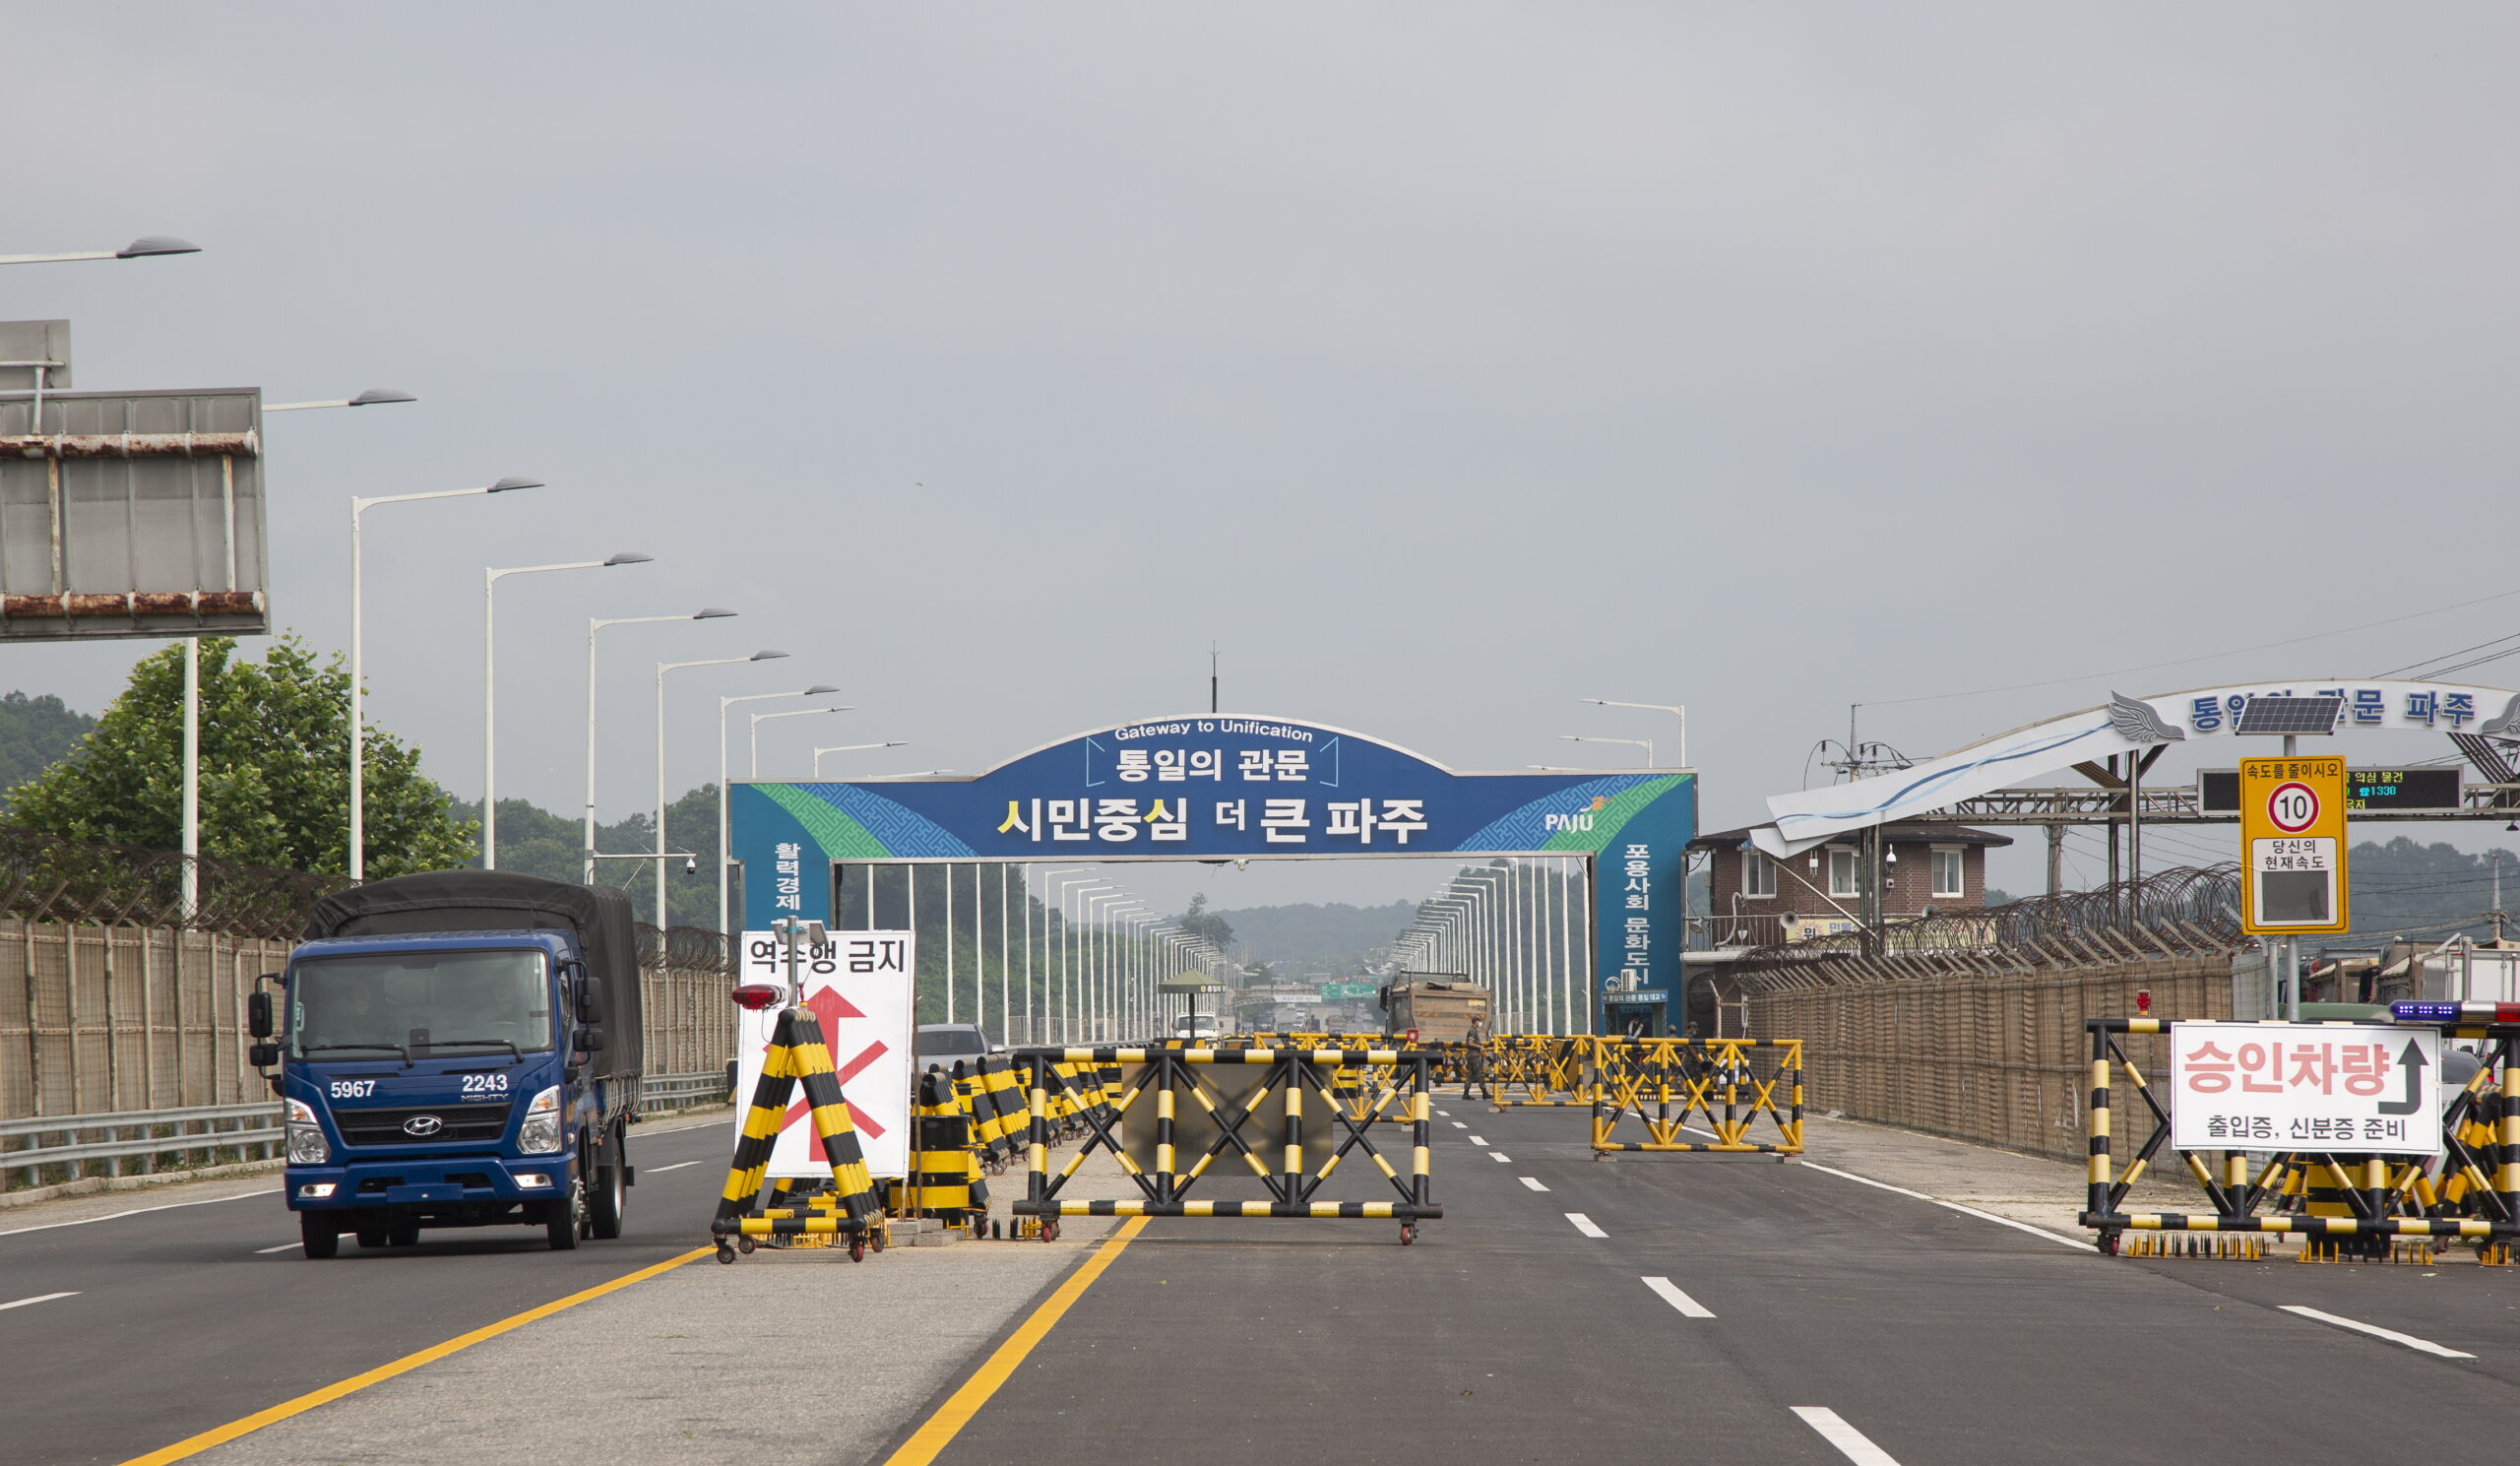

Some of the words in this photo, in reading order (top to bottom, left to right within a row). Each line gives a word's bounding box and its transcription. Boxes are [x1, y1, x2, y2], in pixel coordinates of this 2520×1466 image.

[2191, 690, 2294, 732] 통일
[2406, 691, 2476, 727] 파주
[1114, 721, 1190, 741] Gateway
[1197, 721, 1214, 733] to
[1221, 720, 1313, 742] Unification
[1115, 749, 1222, 783] 통일의
[1237, 749, 1310, 783] 관문
[2246, 763, 2286, 780] 속도를
[2288, 762, 2340, 779] 줄이시오
[2355, 772, 2377, 784] 의심
[2279, 795, 2308, 820] 10
[997, 797, 1188, 844] 시민중심
[1215, 799, 1246, 832] 더
[1260, 798, 1311, 844] 큰
[1326, 797, 1428, 845] 파주
[1545, 812, 1594, 834] PAJU
[2272, 839, 2317, 855] 당신의
[2264, 855, 2326, 871] 현재속도
[1624, 844, 1652, 911] 포용사회
[848, 939, 905, 974] 금지
[2184, 1041, 2391, 1097] 승인차량
[330, 1079, 376, 1100] 5967
[462, 1074, 508, 1093] 2243
[461, 1093, 509, 1103] MIGHTY
[2207, 1115, 2280, 1141] 출입증,
[2290, 1116, 2356, 1141] 신분증
[2362, 1118, 2407, 1142] 준비
